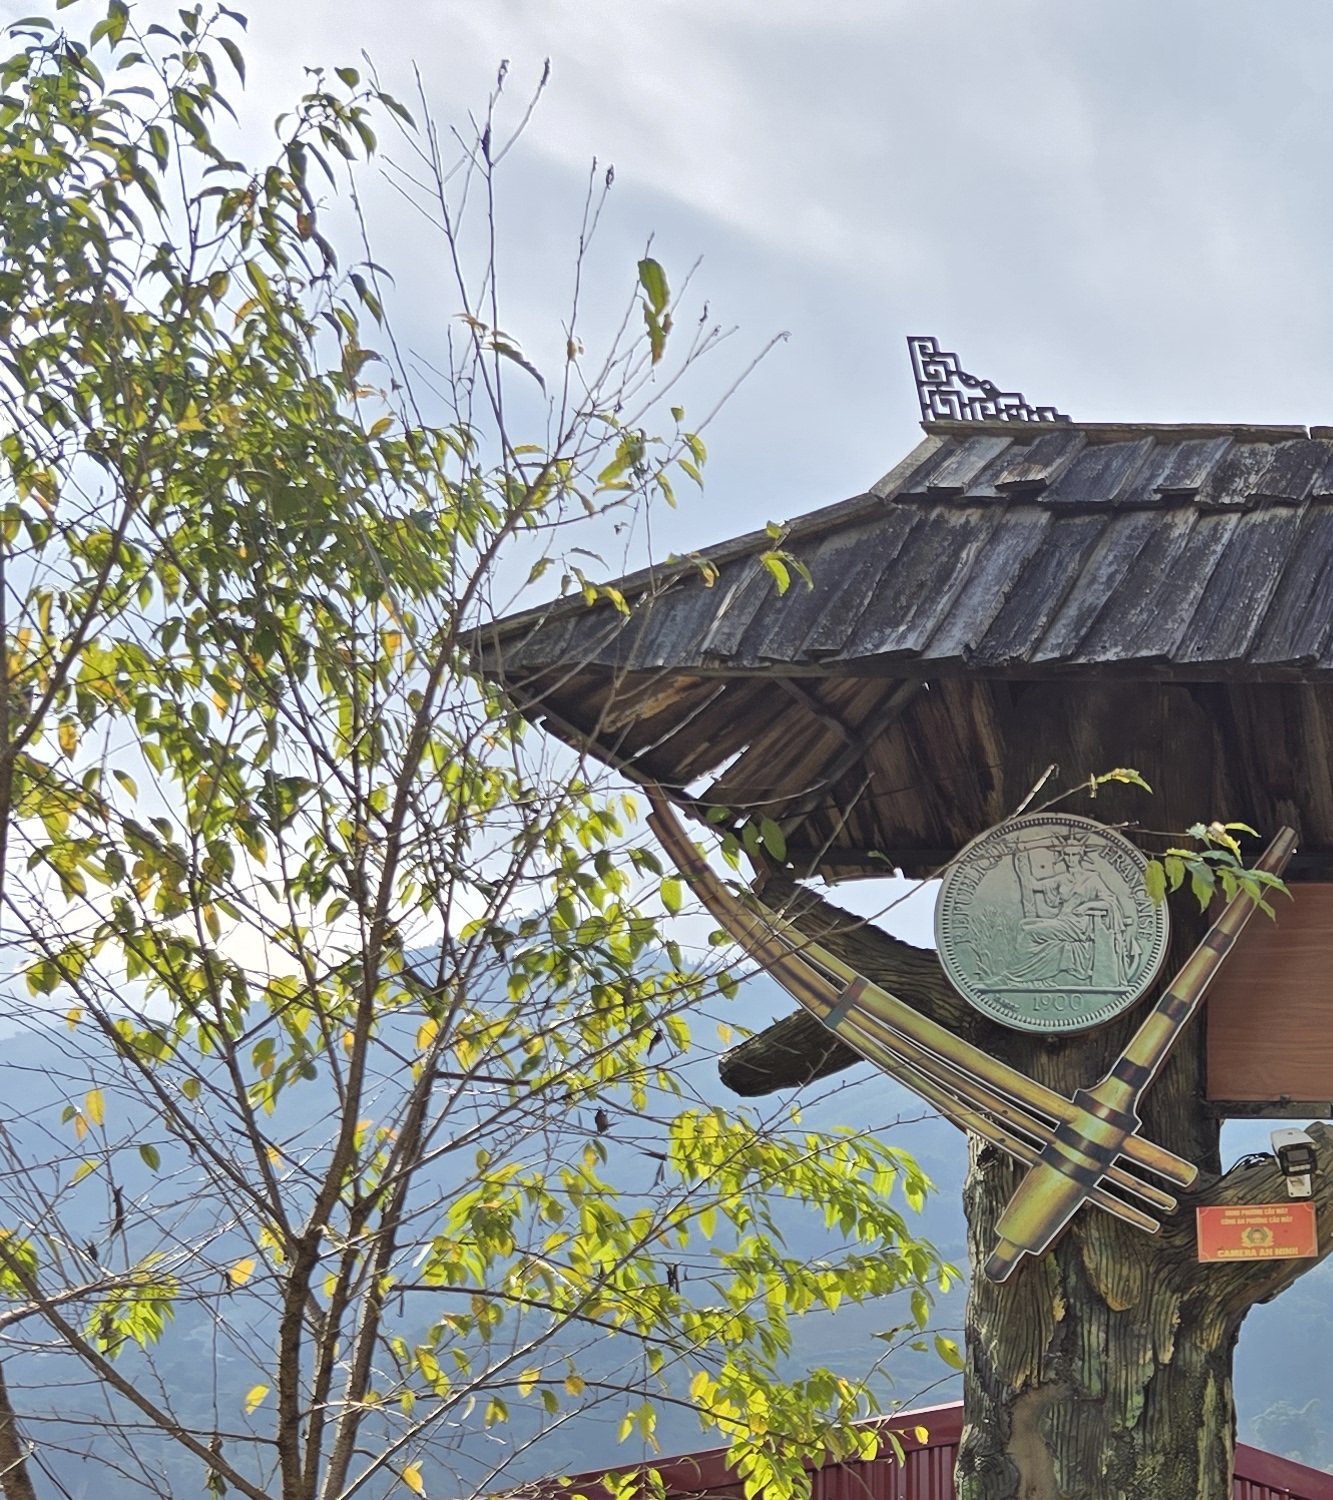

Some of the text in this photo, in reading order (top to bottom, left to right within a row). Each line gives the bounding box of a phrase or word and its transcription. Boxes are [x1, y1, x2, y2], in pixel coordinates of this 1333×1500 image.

[1032, 993, 1084, 1012] 1900
[1217, 1249, 1257, 1258] CAMERA
[1259, 1248, 1273, 1256] AN
